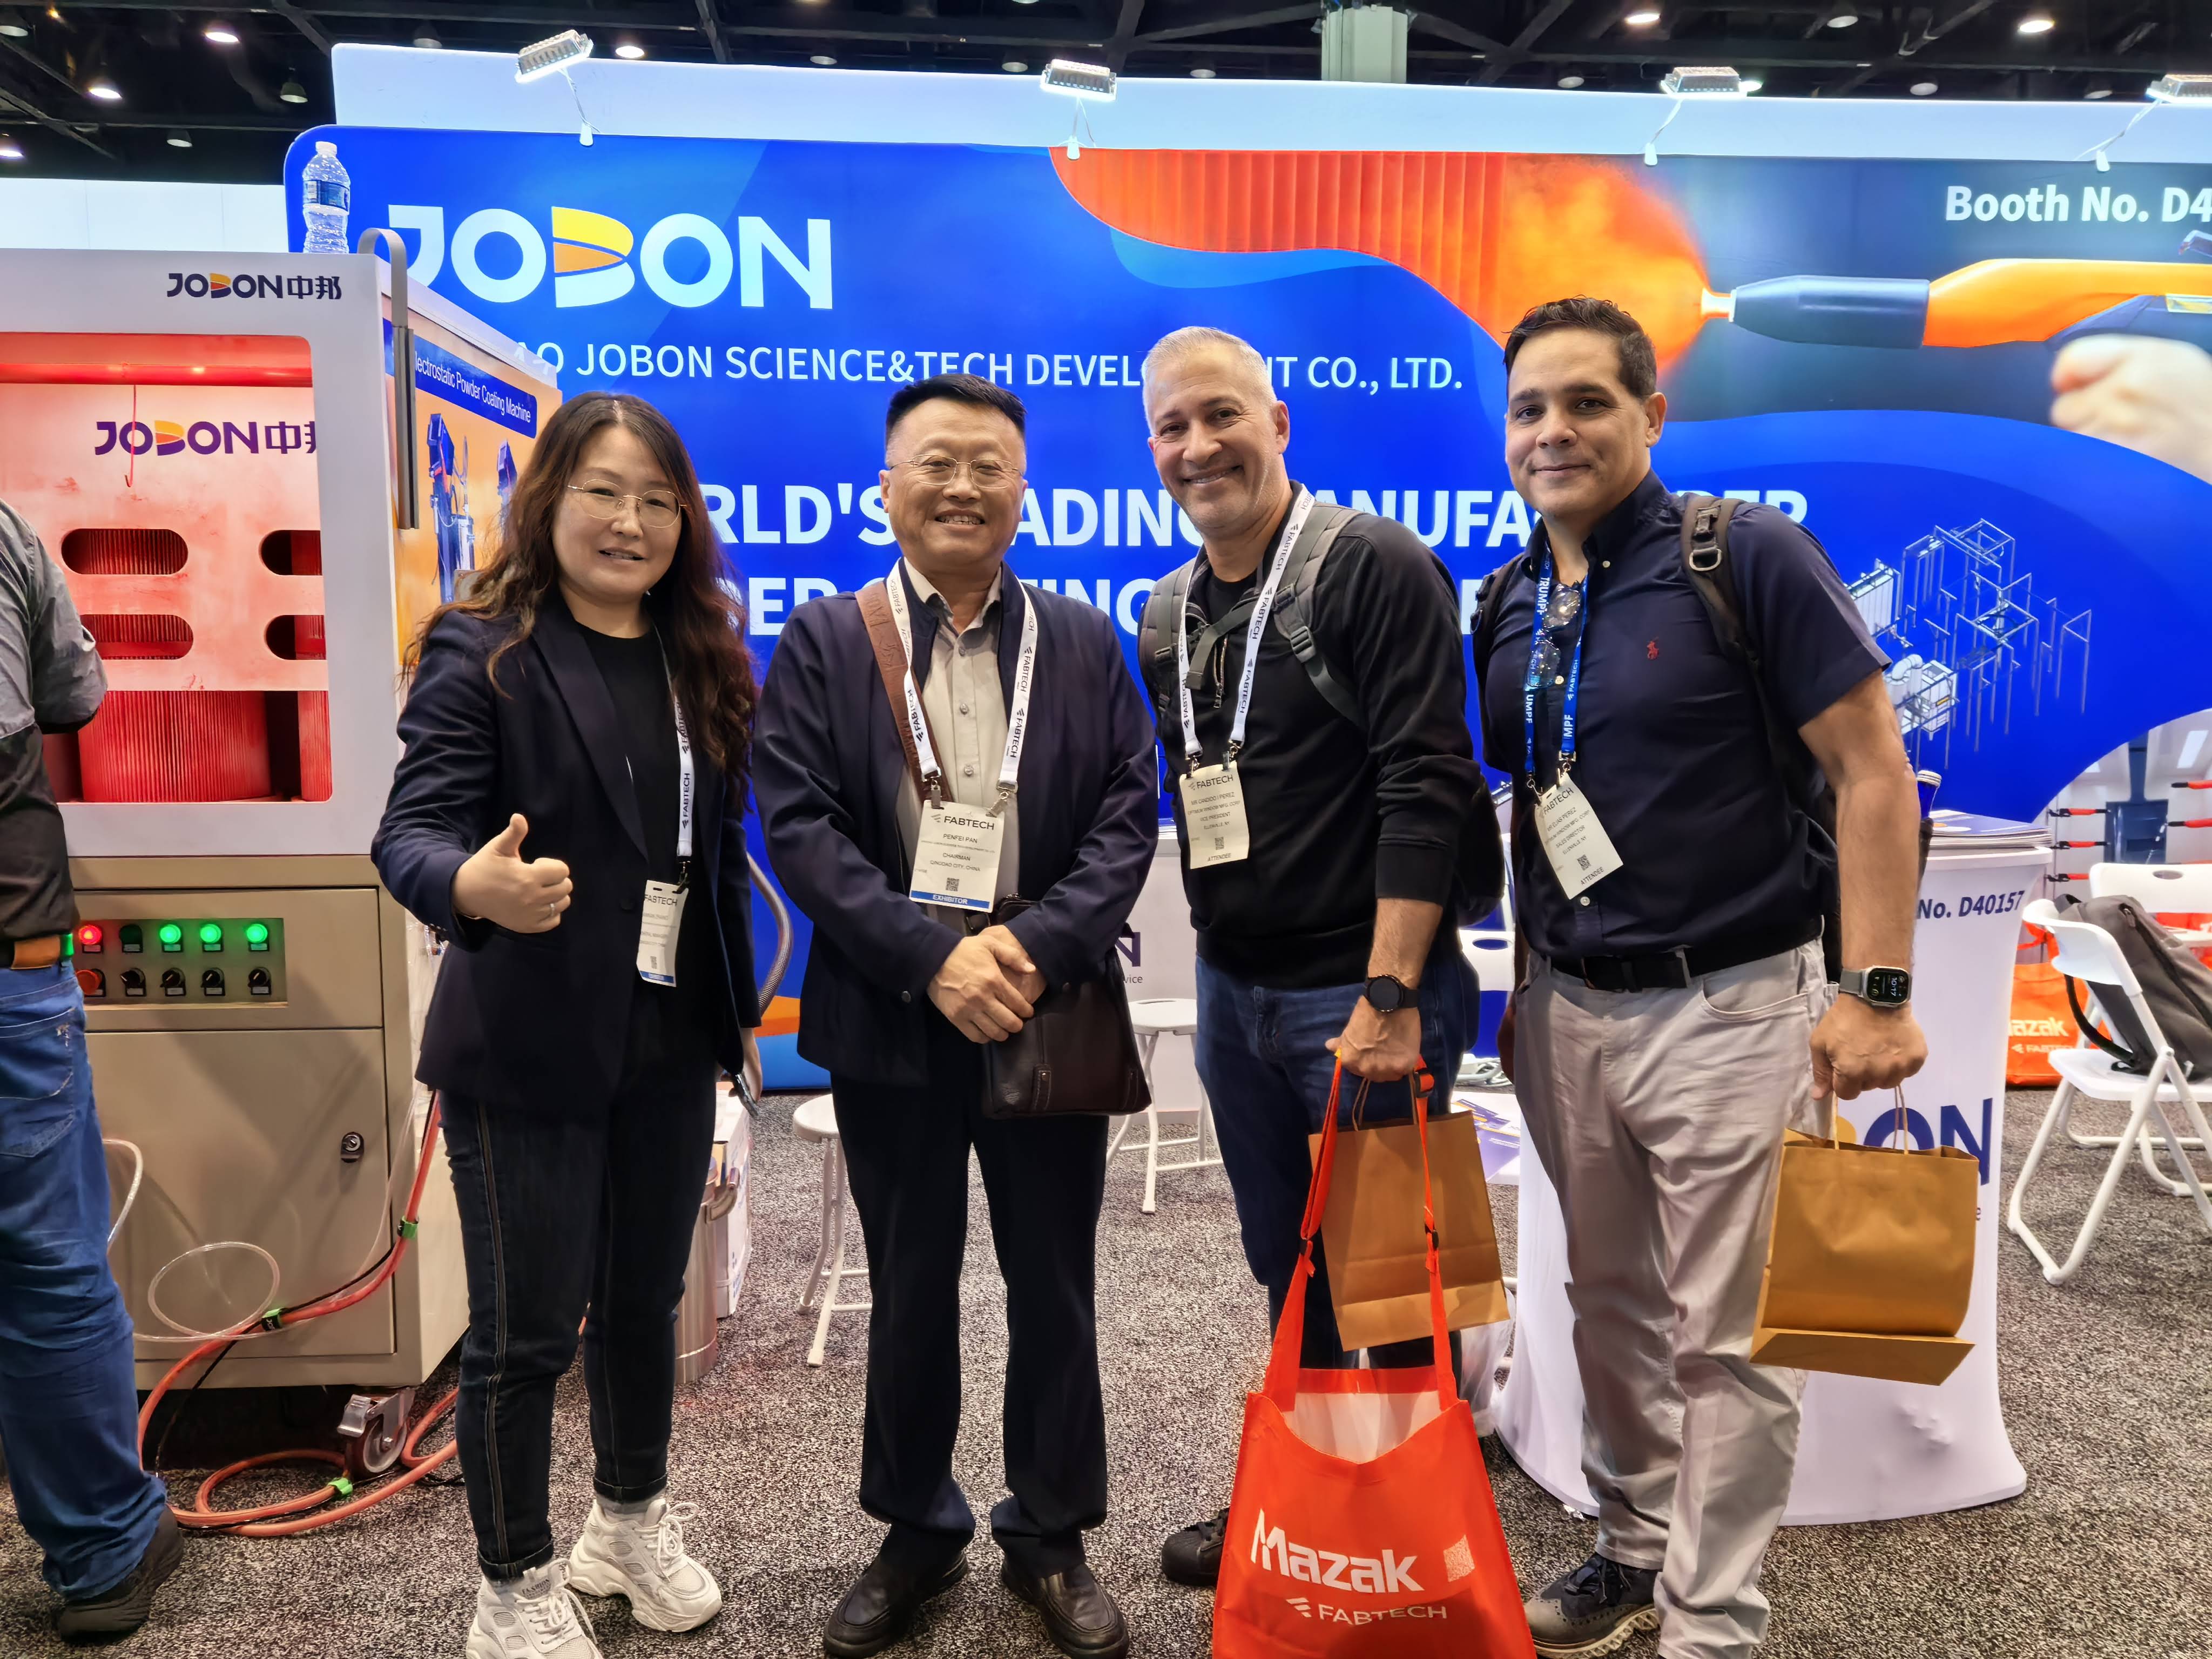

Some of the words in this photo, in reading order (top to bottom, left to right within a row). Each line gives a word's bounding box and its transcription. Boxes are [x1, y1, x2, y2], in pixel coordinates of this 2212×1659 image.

[1946, 184, 2069, 222] Booth
[2081, 187, 2149, 222] No.
[388, 204, 833, 309] JOBON
[167, 273, 283, 299] JOBON
[287, 275, 342, 300] 中邦
[576, 343, 712, 377] JOBON
[725, 346, 1013, 385] SCIENCE&TECH
[1307, 356, 1379, 395] CO.,
[1391, 358, 1462, 389] LTD.
[415, 351, 455, 388] lectrostatic
[456, 371, 481, 400] Powder
[482, 385, 505, 416] Coating
[505, 397, 531, 423] Machine
[95, 420, 259, 456] JOBON
[699, 483, 898, 545] RLD'S
[1276, 531, 1295, 570] FABTECH
[891, 578, 900, 606] FABTECH
[1251, 597, 1269, 640] FABTECH
[1021, 655, 1032, 692] FABTECH
[1569, 659, 1579, 692] FABTECH
[1240, 670, 1252, 714] FABTECH
[1526, 694, 1534, 724] UMPF
[1010, 718, 1023, 758] FABTECH
[1563, 714, 1574, 738] MPF
[683, 773, 691, 817] FABTECH
[1197, 774, 1234, 789] FABTECH
[1543, 787, 1574, 815] FABTECH
[943, 815, 995, 831] FABTECH
[942, 853, 972, 861] CHAIRMAN
[1207, 853, 1232, 862] ATTENDEE
[1581, 866, 1604, 885] ATTENDEE
[933, 894, 968, 905] EXHIBITOR
[1918, 899, 1951, 919] No.
[1958, 890, 2026, 917] D40157
[2008, 1016, 2069, 1037] azak
[1250, 1508, 1425, 1594] Mazak
[1318, 1603, 1447, 1626] FABTECH
